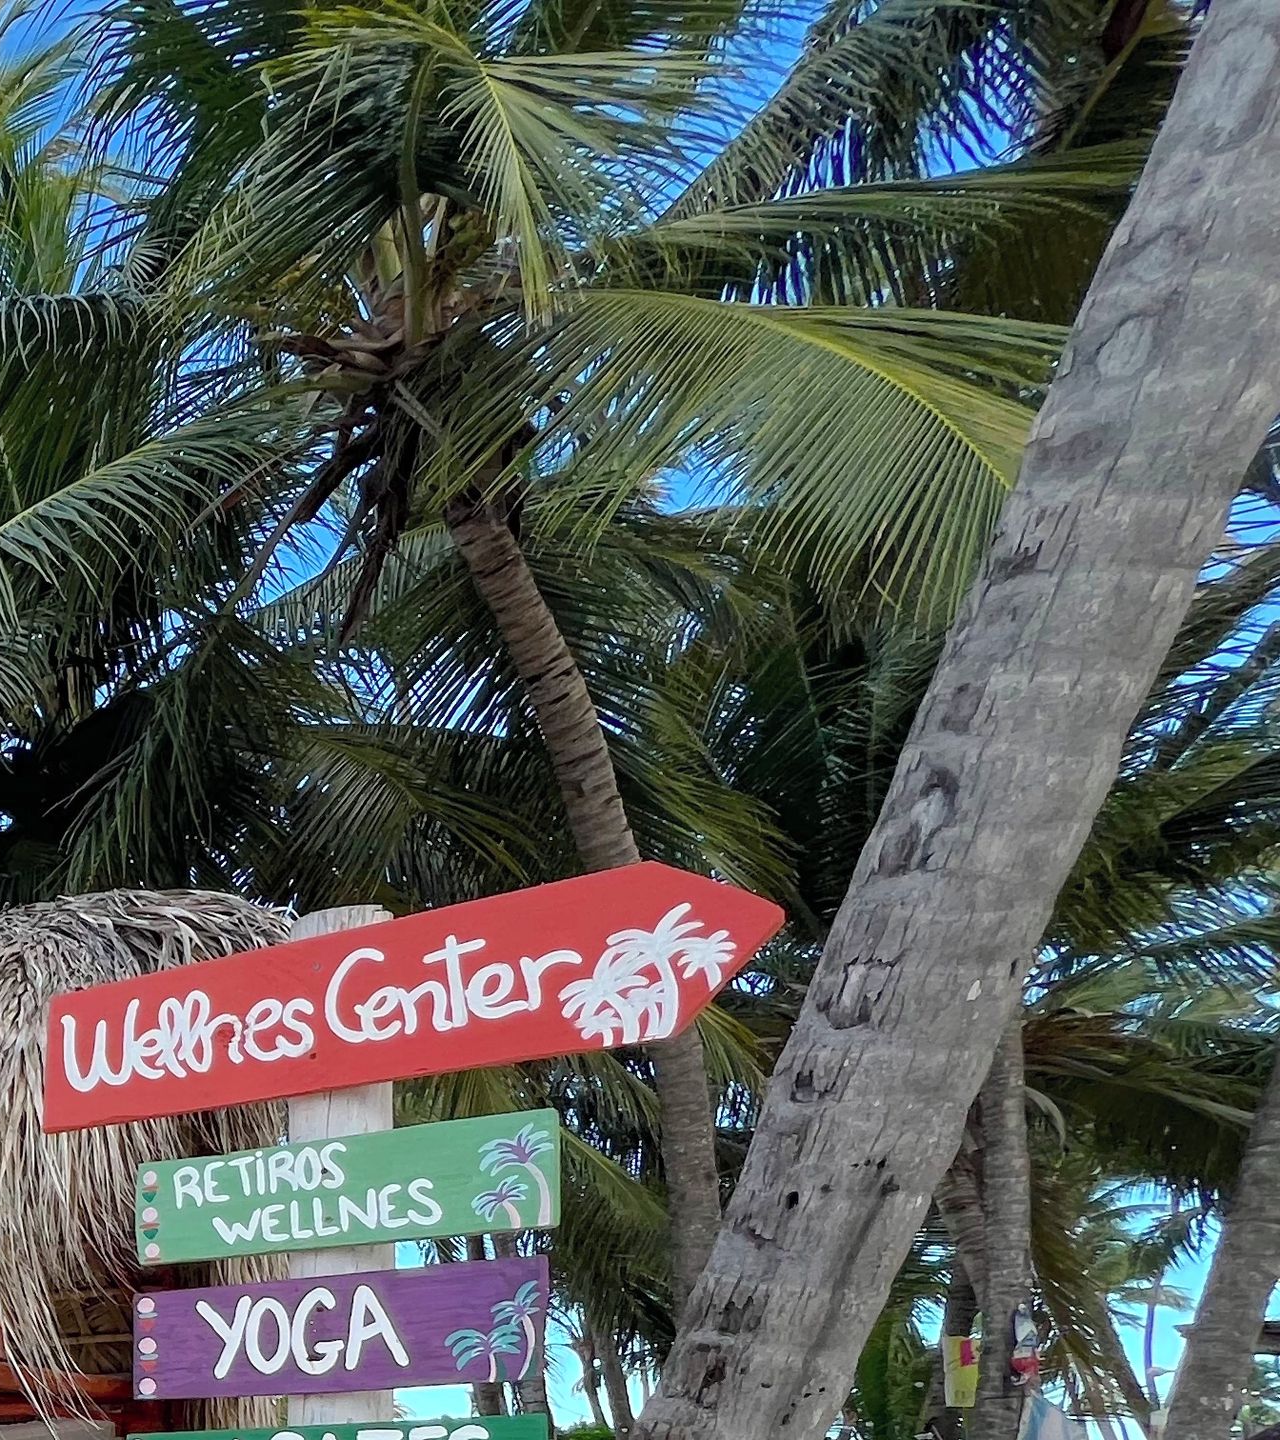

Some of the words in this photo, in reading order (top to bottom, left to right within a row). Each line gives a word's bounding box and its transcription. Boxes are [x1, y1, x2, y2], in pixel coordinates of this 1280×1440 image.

[62, 990, 316, 1093] Wellnes
[325, 934, 583, 1044] Center
[211, 1178, 442, 1244] WELLNES
[196, 1285, 409, 1379] YOGA
